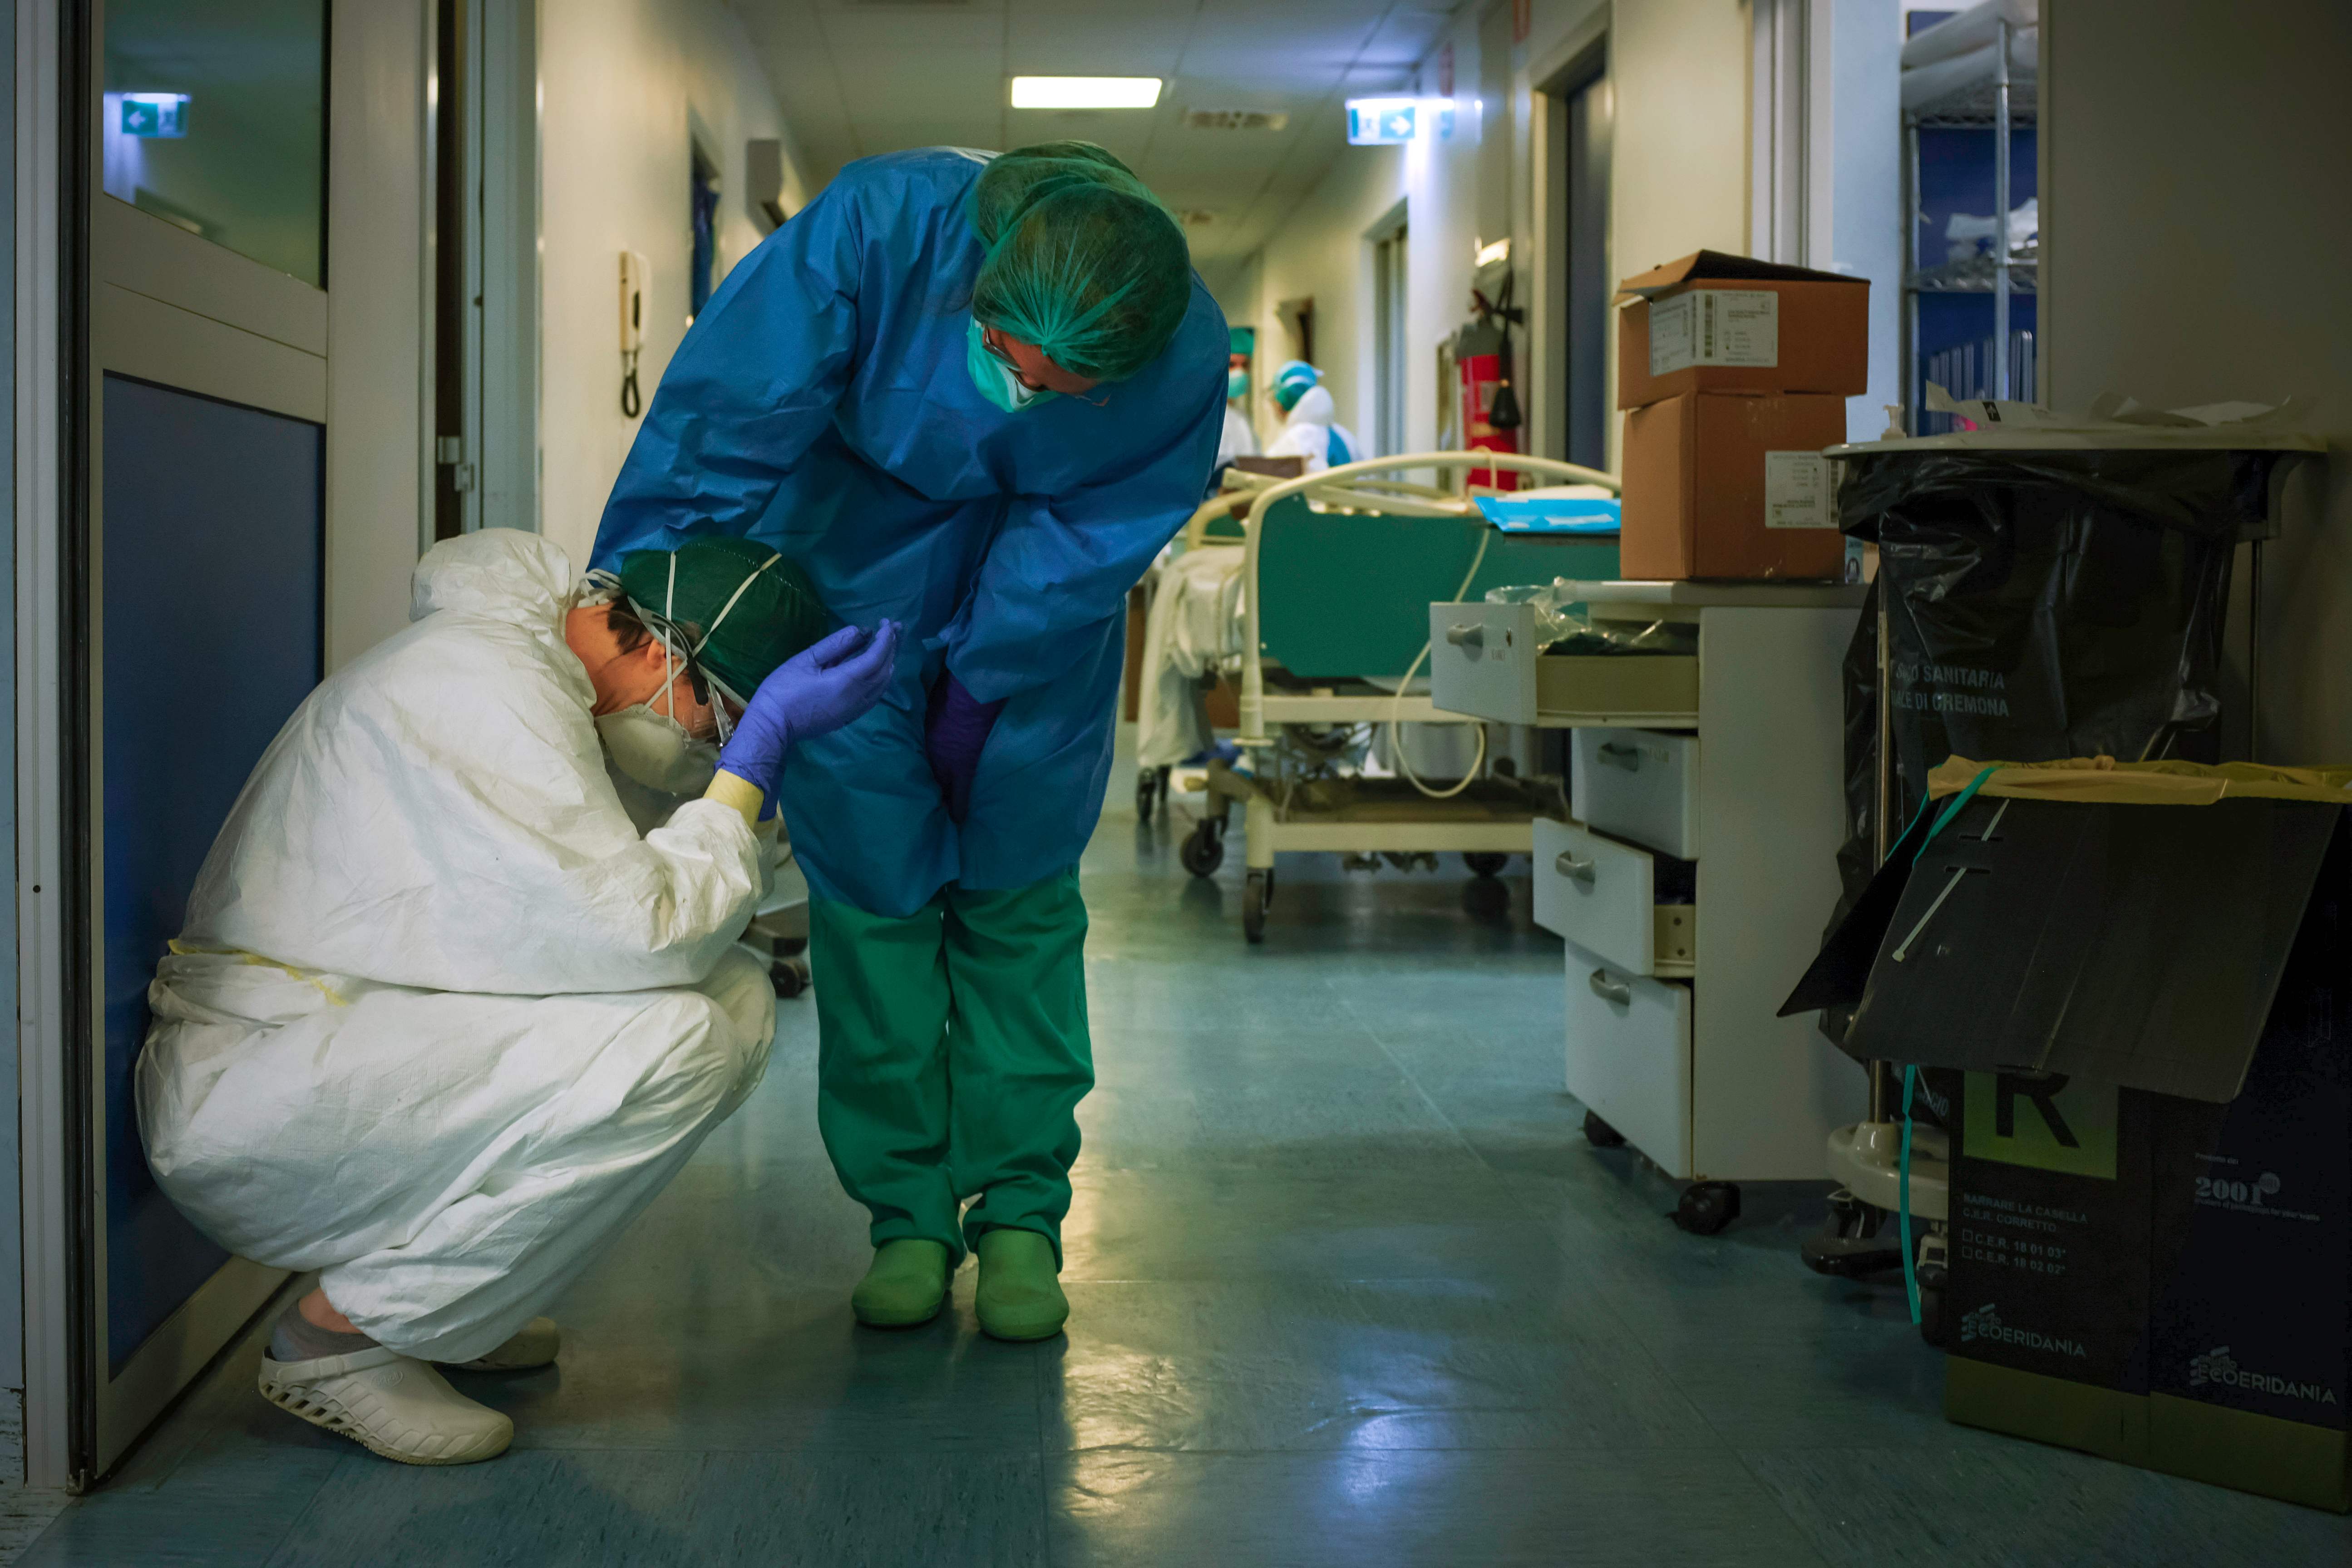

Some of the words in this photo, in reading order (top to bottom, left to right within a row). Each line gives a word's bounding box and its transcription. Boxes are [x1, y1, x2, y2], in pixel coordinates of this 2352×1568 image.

[1923, 664, 2005, 689] SANITARIA
[1915, 692, 1928, 710] DI
[1932, 692, 2009, 717] CREMONA
[1996, 1071, 2080, 1148] R
[1996, 1213, 2057, 1232] CORRETTO
[2018, 1202, 2032, 1214] LA
[2035, 1206, 2088, 1224] CASELLA
[1975, 1233, 2009, 1249] C.E.R.
[2014, 1241, 2027, 1252] 18
[2030, 1243, 2043, 1256] 01
[1975, 1249, 2009, 1266] C.E.R.
[2014, 1257, 2027, 1268] 18
[2030, 1260, 2044, 1272] 02
